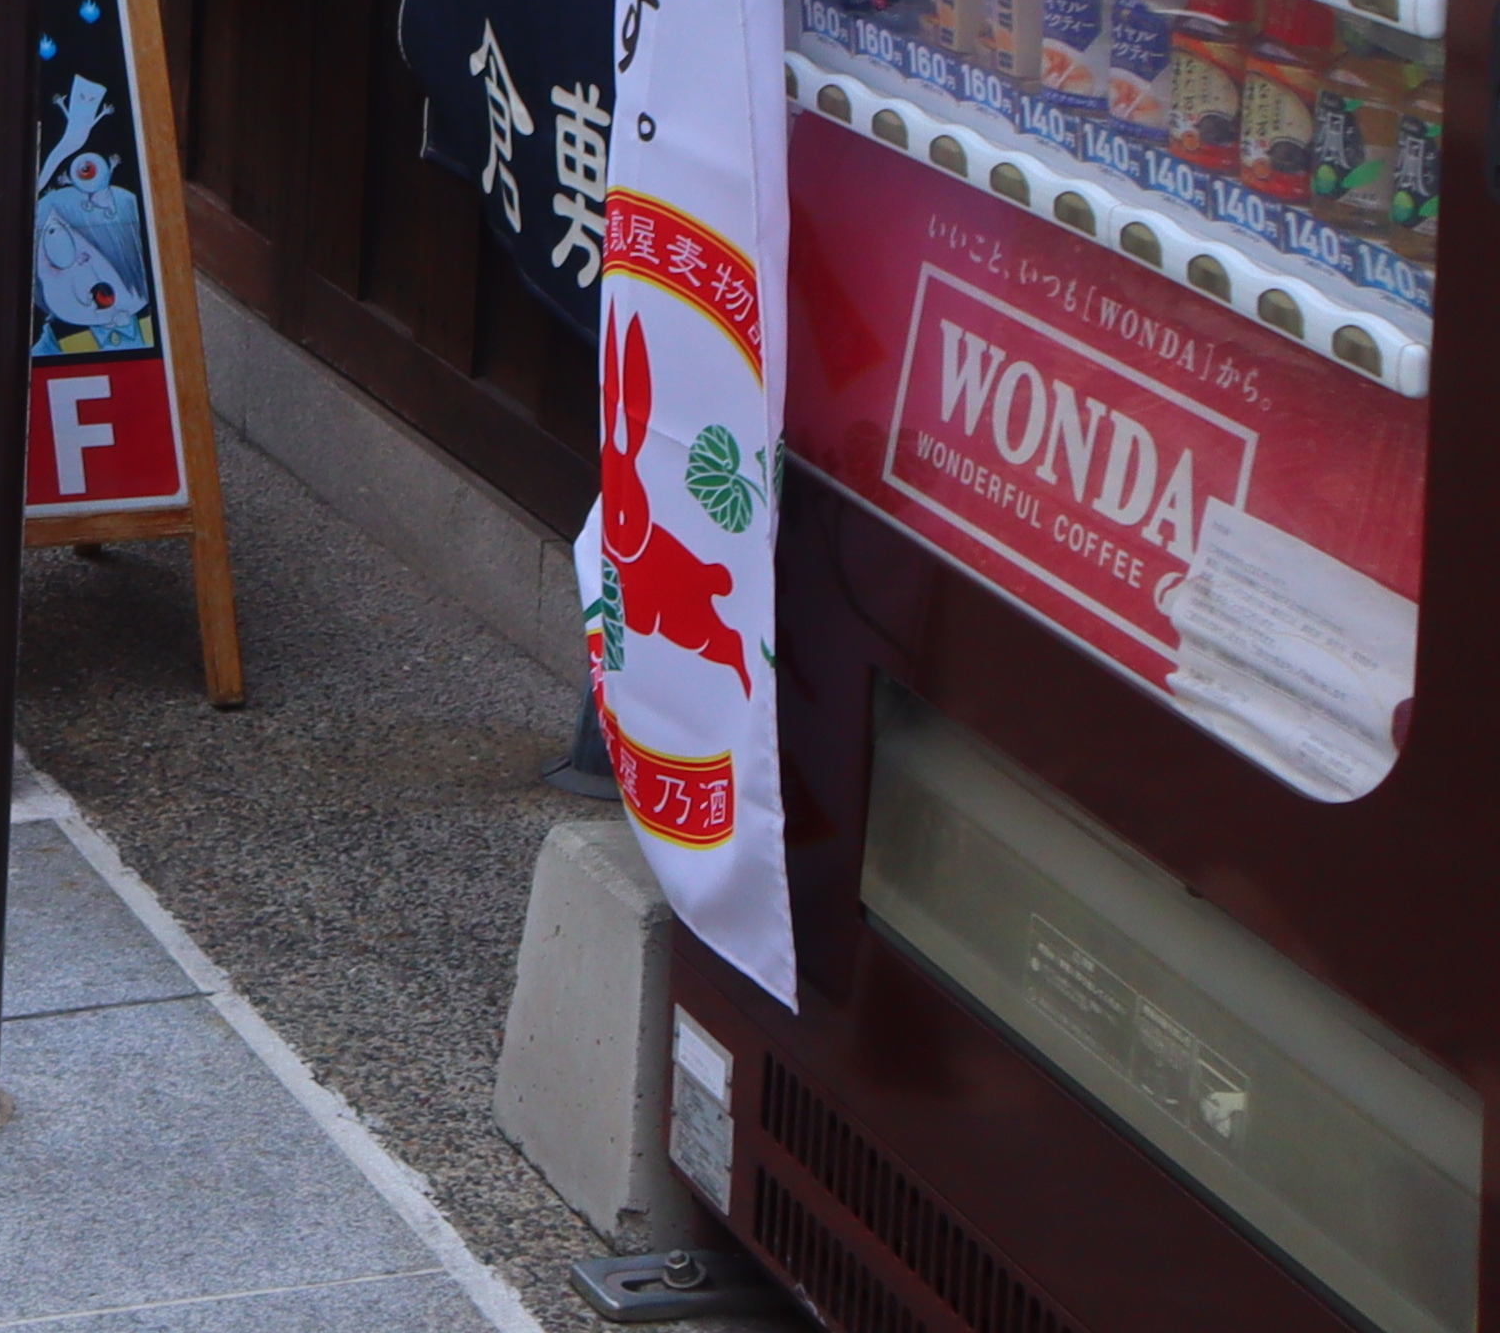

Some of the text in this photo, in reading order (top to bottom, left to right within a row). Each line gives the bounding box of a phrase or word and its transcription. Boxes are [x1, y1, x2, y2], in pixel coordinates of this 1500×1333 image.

[916, 431, 1146, 590] WONDERFUL COFFEE
[940, 318, 1199, 566] WONDA
